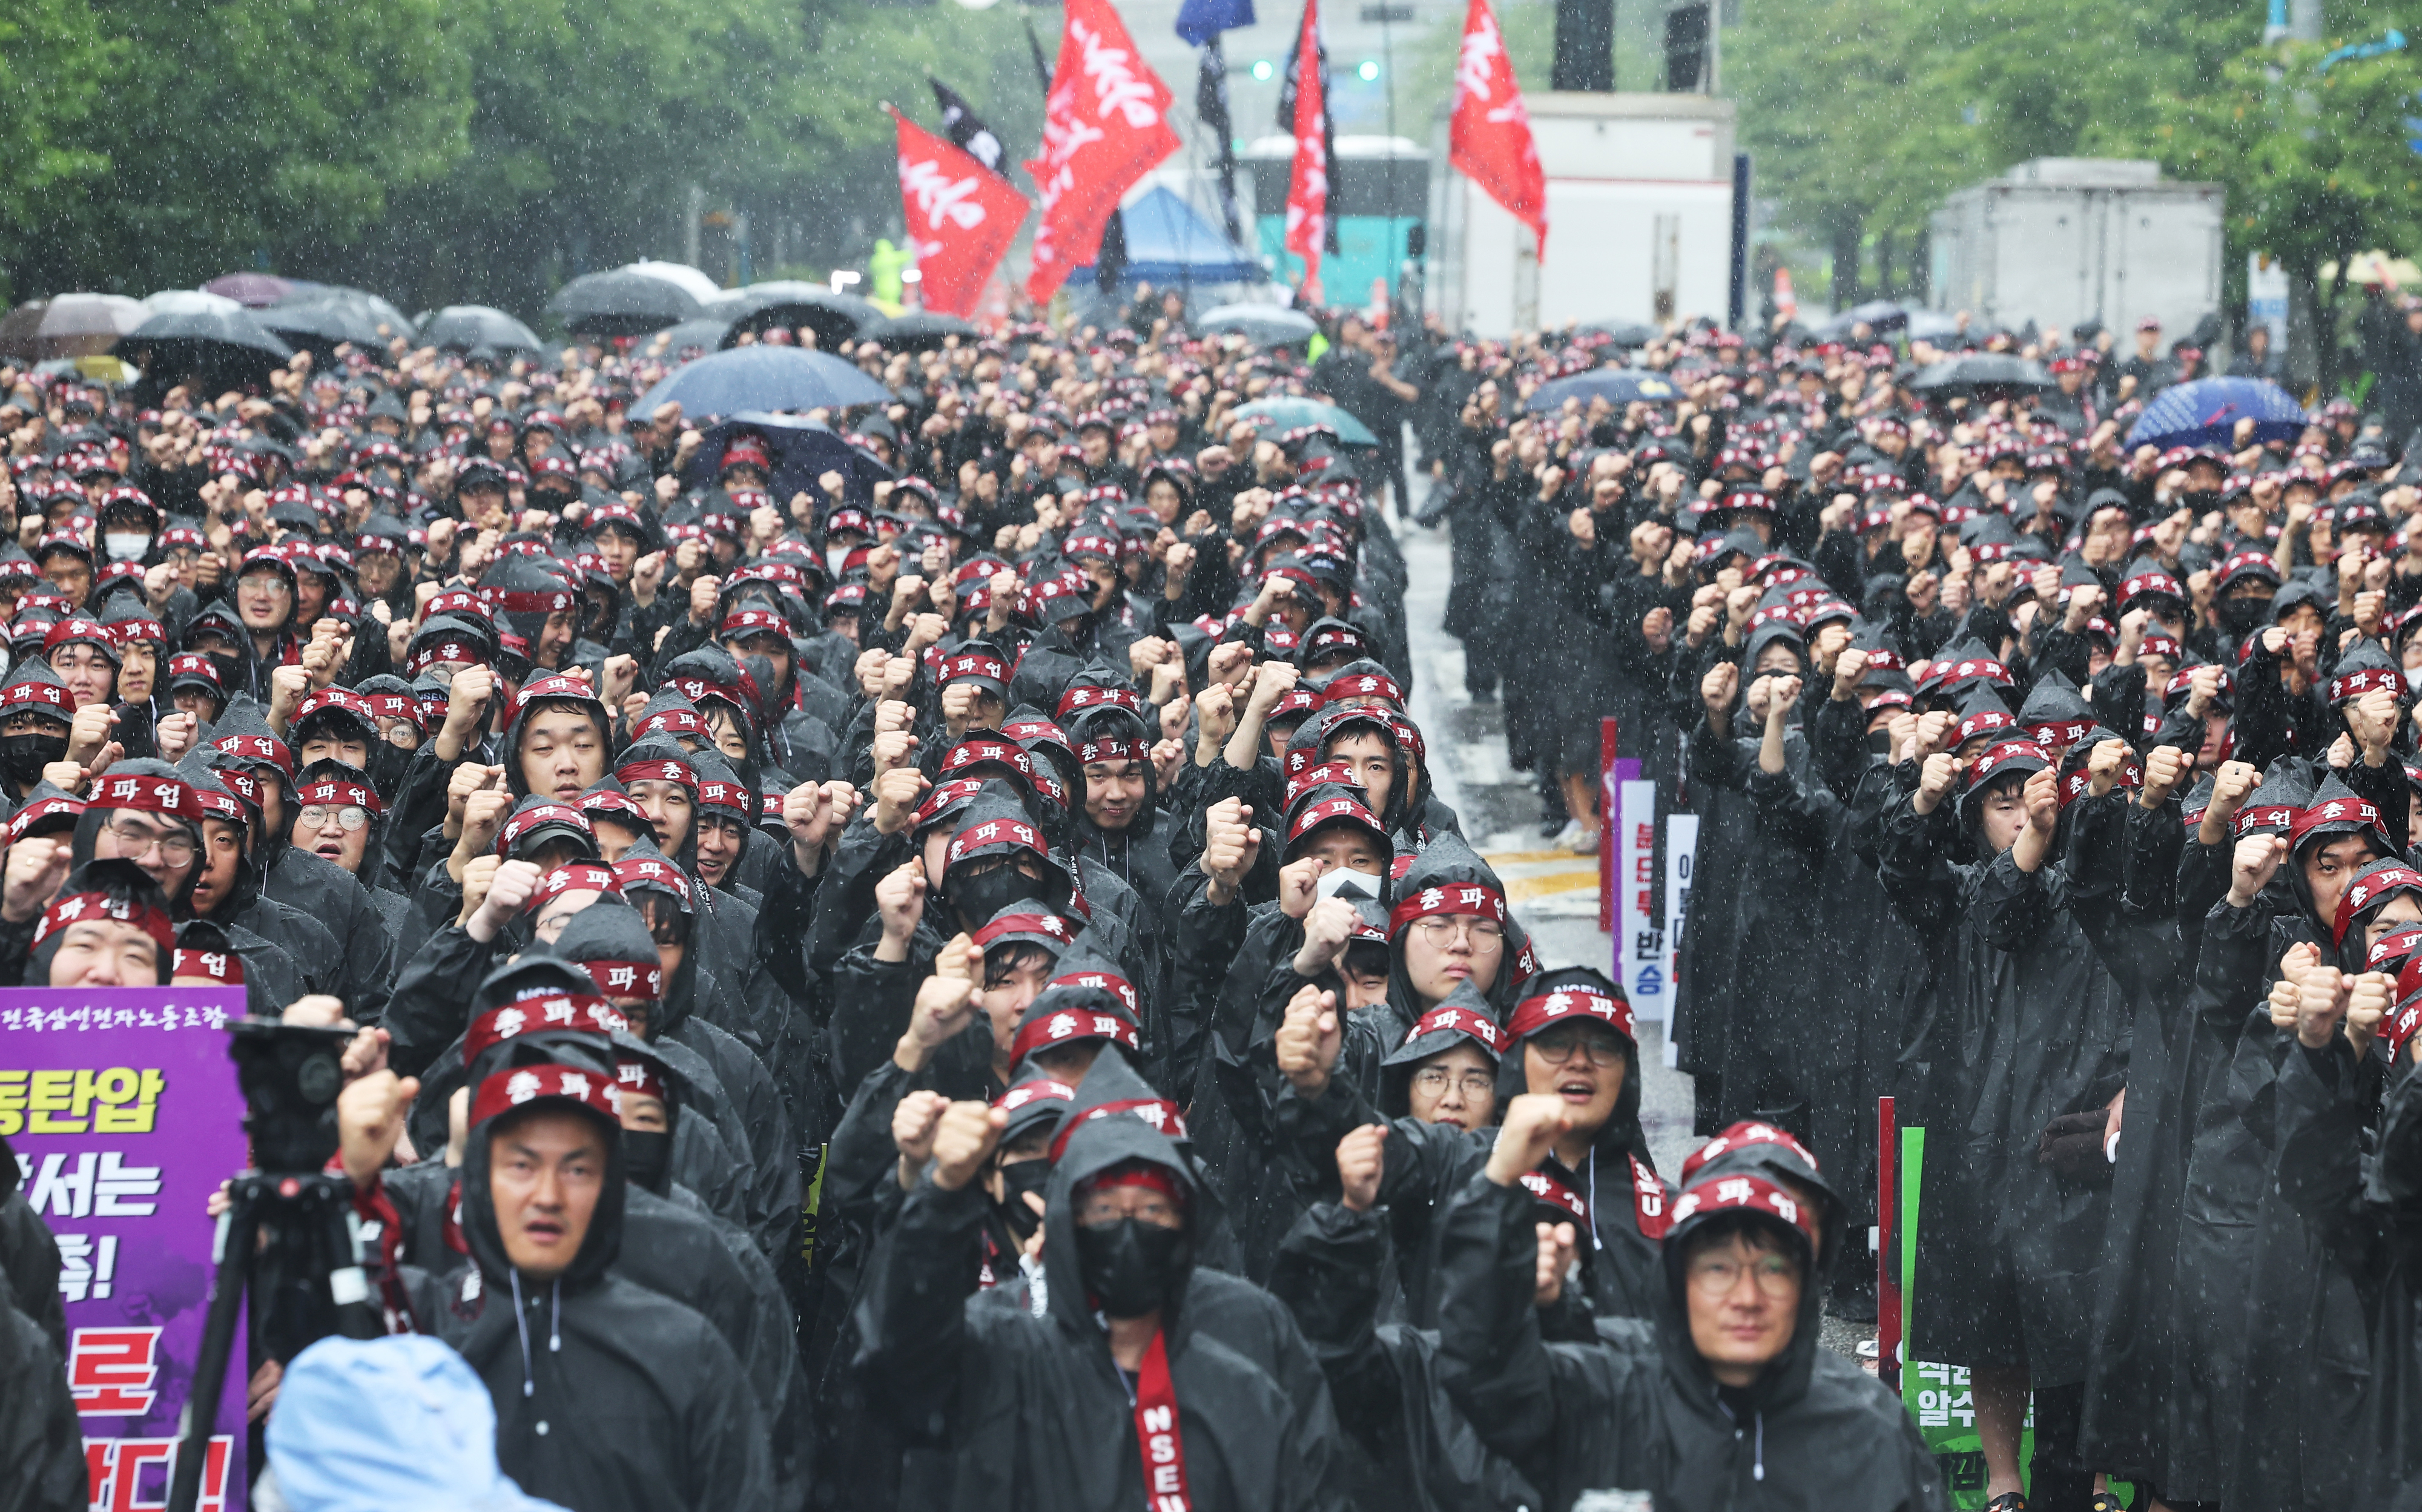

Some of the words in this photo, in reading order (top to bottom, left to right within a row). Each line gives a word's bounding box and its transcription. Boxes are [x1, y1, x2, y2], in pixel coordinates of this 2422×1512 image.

[429, 593, 489, 616] 총파업
[939, 658, 1001, 681] 총파업
[301, 692, 374, 718] 총파업
[1072, 689, 1141, 713] 총파업
[220, 736, 273, 756] 파업
[954, 745, 1029, 774] 총파업
[705, 784, 749, 811] 파업
[504, 805, 589, 842] 총파업
[1299, 800, 1381, 831] 총파업
[949, 822, 1033, 860] 총파업
[1419, 886, 1504, 921] 총파업
[1, 1005, 229, 1032] 전국삼성전자노동조합
[493, 997, 609, 1039] 총파업
